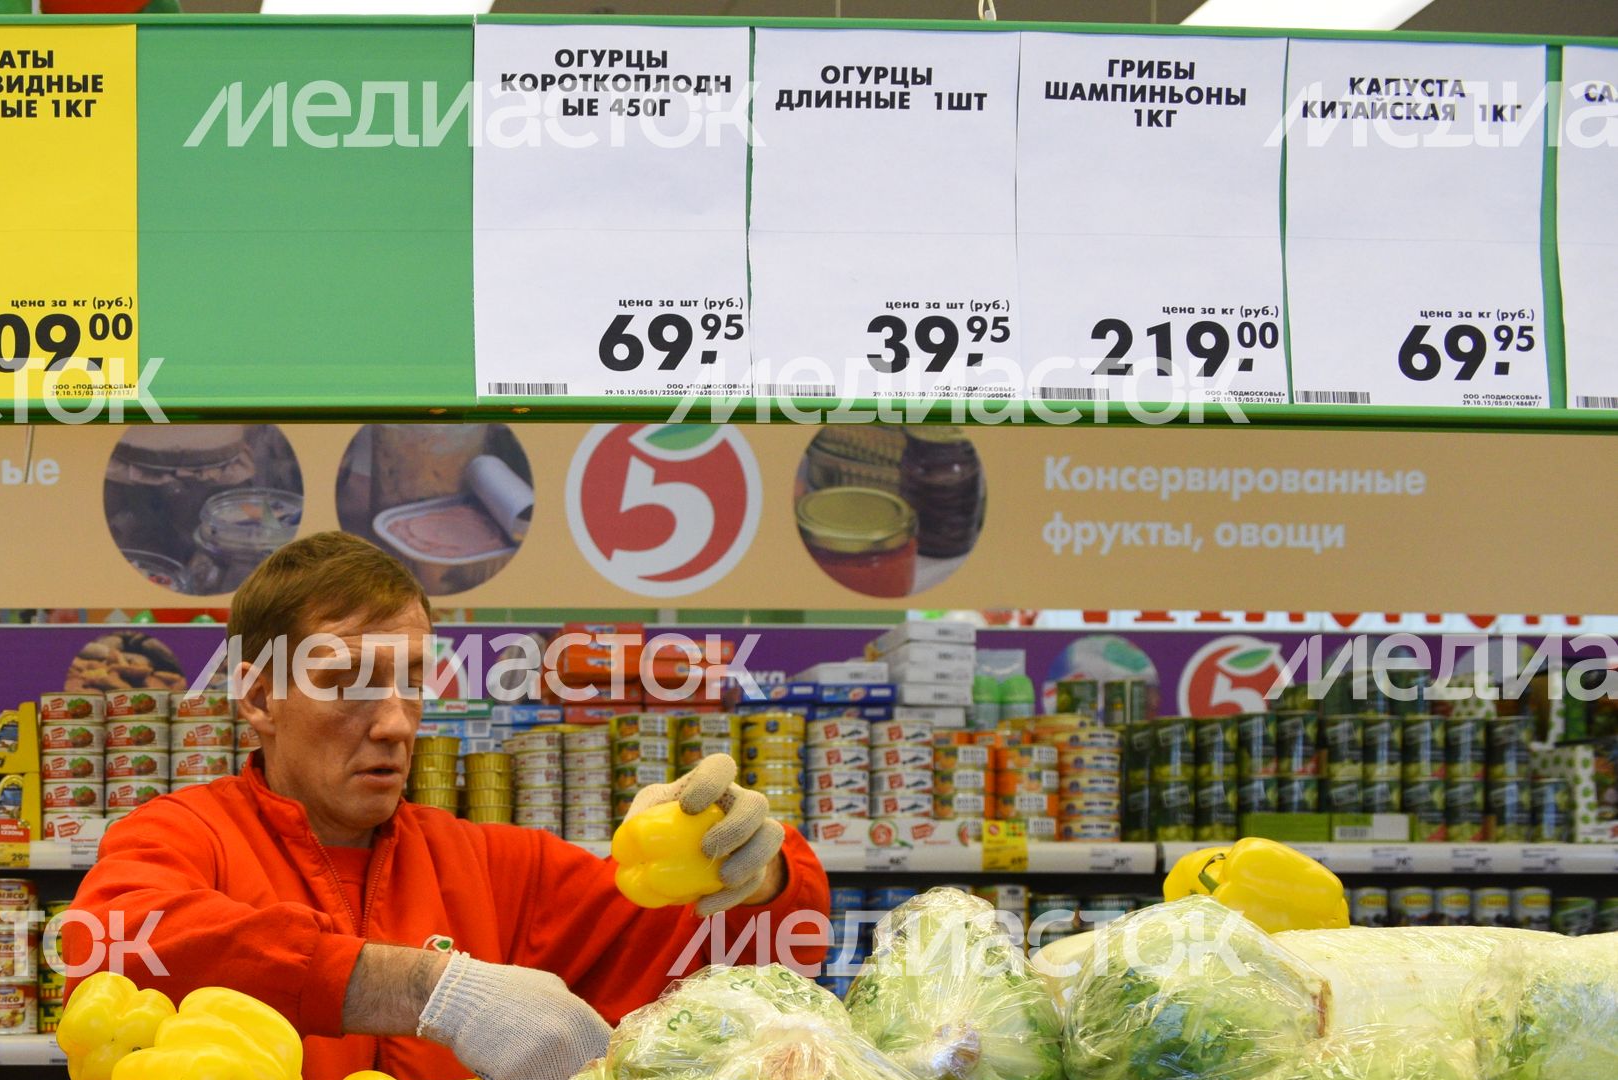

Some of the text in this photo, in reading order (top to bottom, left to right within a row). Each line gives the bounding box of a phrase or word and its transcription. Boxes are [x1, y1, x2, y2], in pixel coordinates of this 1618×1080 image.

[555, 49, 667, 71] ОГУРЦЫ
[1108, 59, 1195, 80] ГРИБЫ
[501, 70, 731, 100] КОРОТКОПЛОДН
[821, 65, 932, 91] ОГУРЦЫ
[775, 86, 987, 111] ДЛИННЫЕ 1ШТ
[1045, 78, 1246, 110] ШАМПИНЬОНЫ
[1349, 77, 1466, 101] КАПУСТА
[52, 99, 96, 118] 1КГ
[563, 98, 671, 117] ЫЕ 450Г
[1134, 109, 1177, 127] 1КГ
[1302, 95, 1522, 122] КИТАЙСКАЯ 1КГ
[11, 300, 45, 309] цена
[93, 297, 132, 309] (руб.)
[619, 300, 653, 308] цена
[704, 297, 743, 310] (руб.)
[886, 302, 919, 310] цена
[970, 299, 1010, 312] (руб.)
[1162, 306, 1195, 315] цена
[1240, 305, 1278, 318] (руб.)
[1420, 310, 1452, 319] цена
[1497, 309, 1534, 321] (руб.)
[1043, 456, 1427, 495] Консервированные
[1042, 511, 1346, 554] фрукты, овощи
